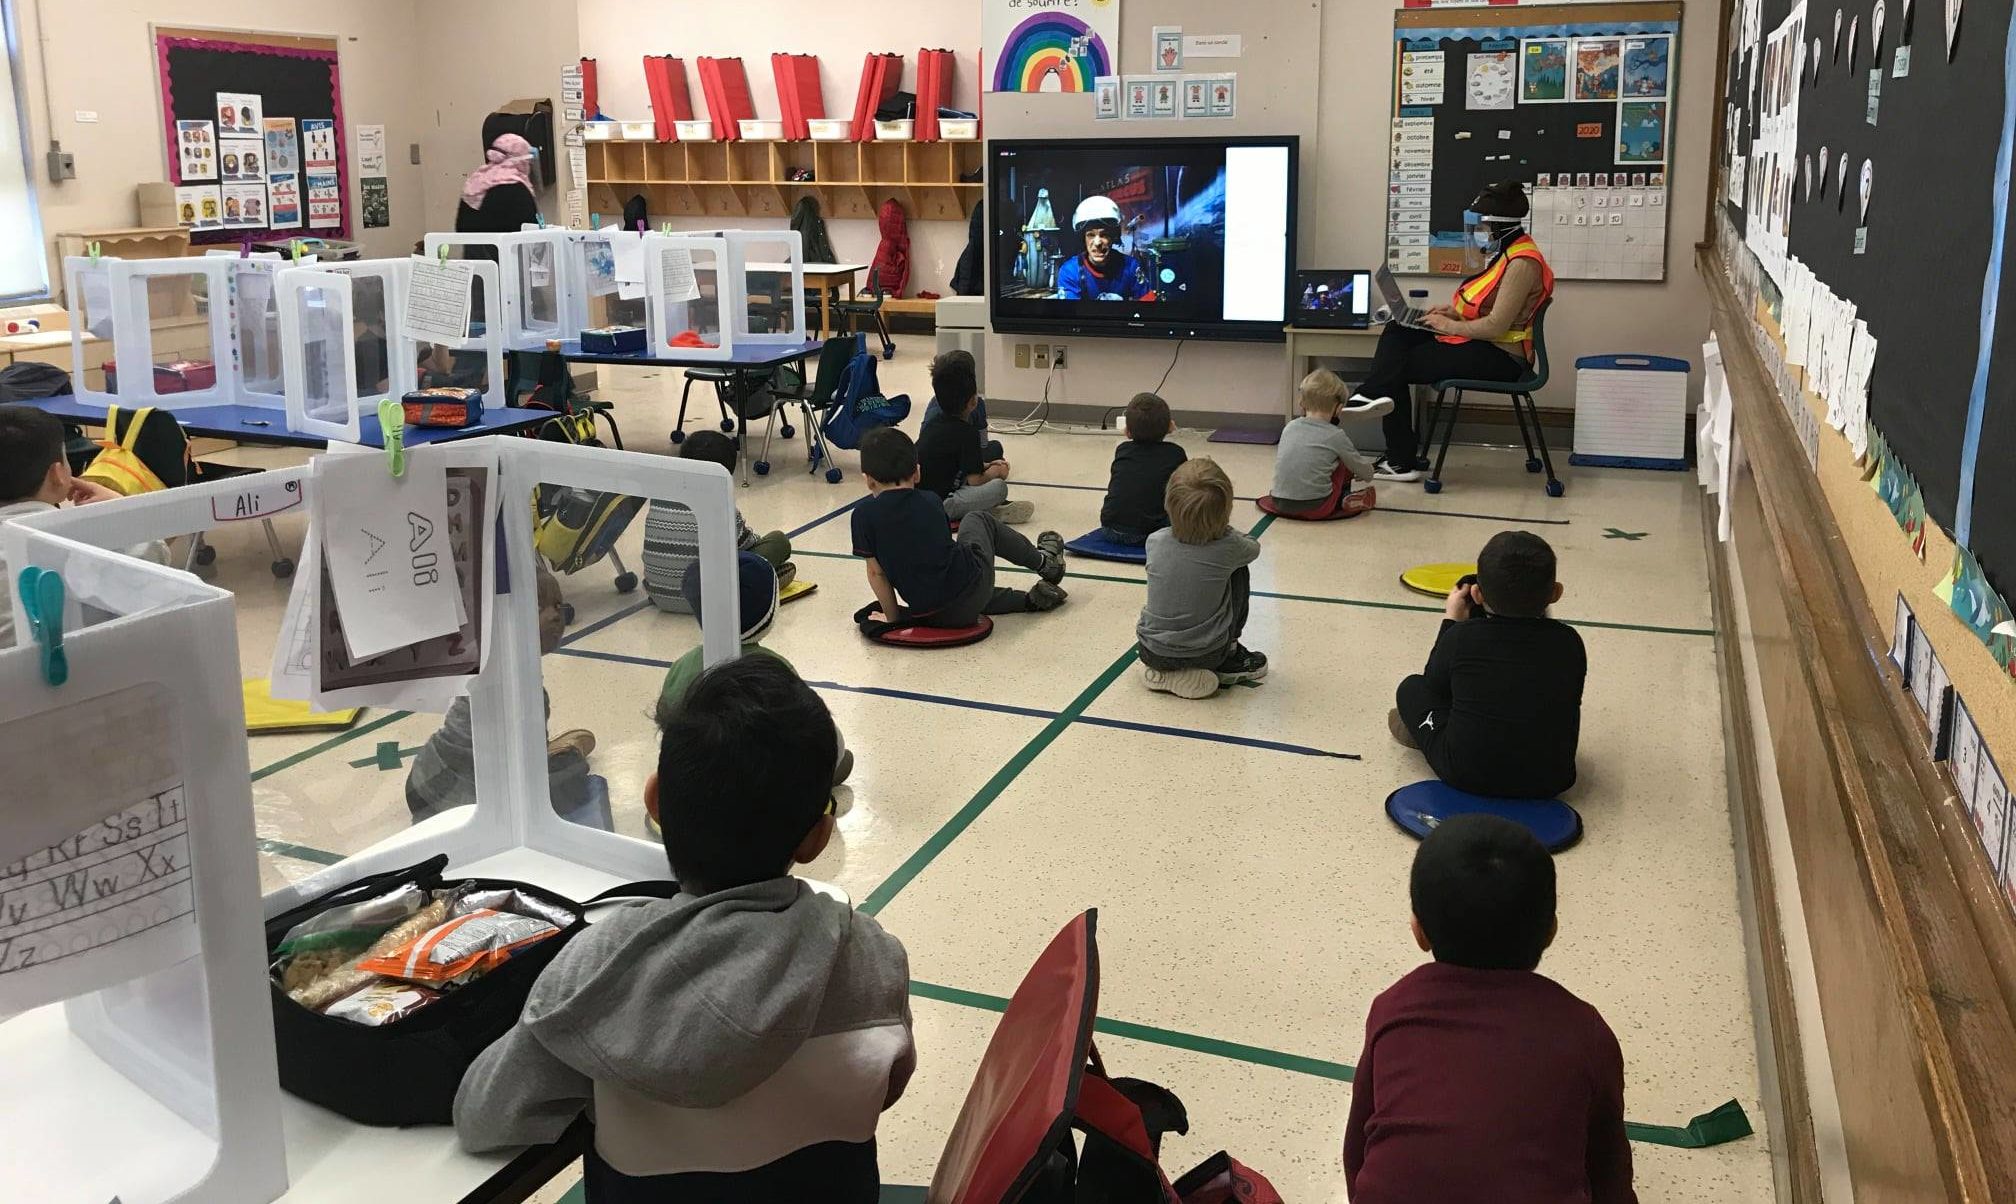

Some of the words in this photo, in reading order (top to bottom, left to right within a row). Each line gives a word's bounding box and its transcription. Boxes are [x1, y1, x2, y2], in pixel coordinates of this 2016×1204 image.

[1415, 53, 1443, 61] printemps
[310, 121, 325, 130] AVIS
[1577, 126, 1601, 135] 2020
[1407, 133, 1430, 141] octobre
[317, 179, 335, 189] MAINS
[1441, 263, 1461, 272] 2021
[235, 493, 260, 517] Ali
[101, 812, 142, 846] Ss
[50, 868, 119, 911] Ww
[136, 843, 177, 884] Xx
